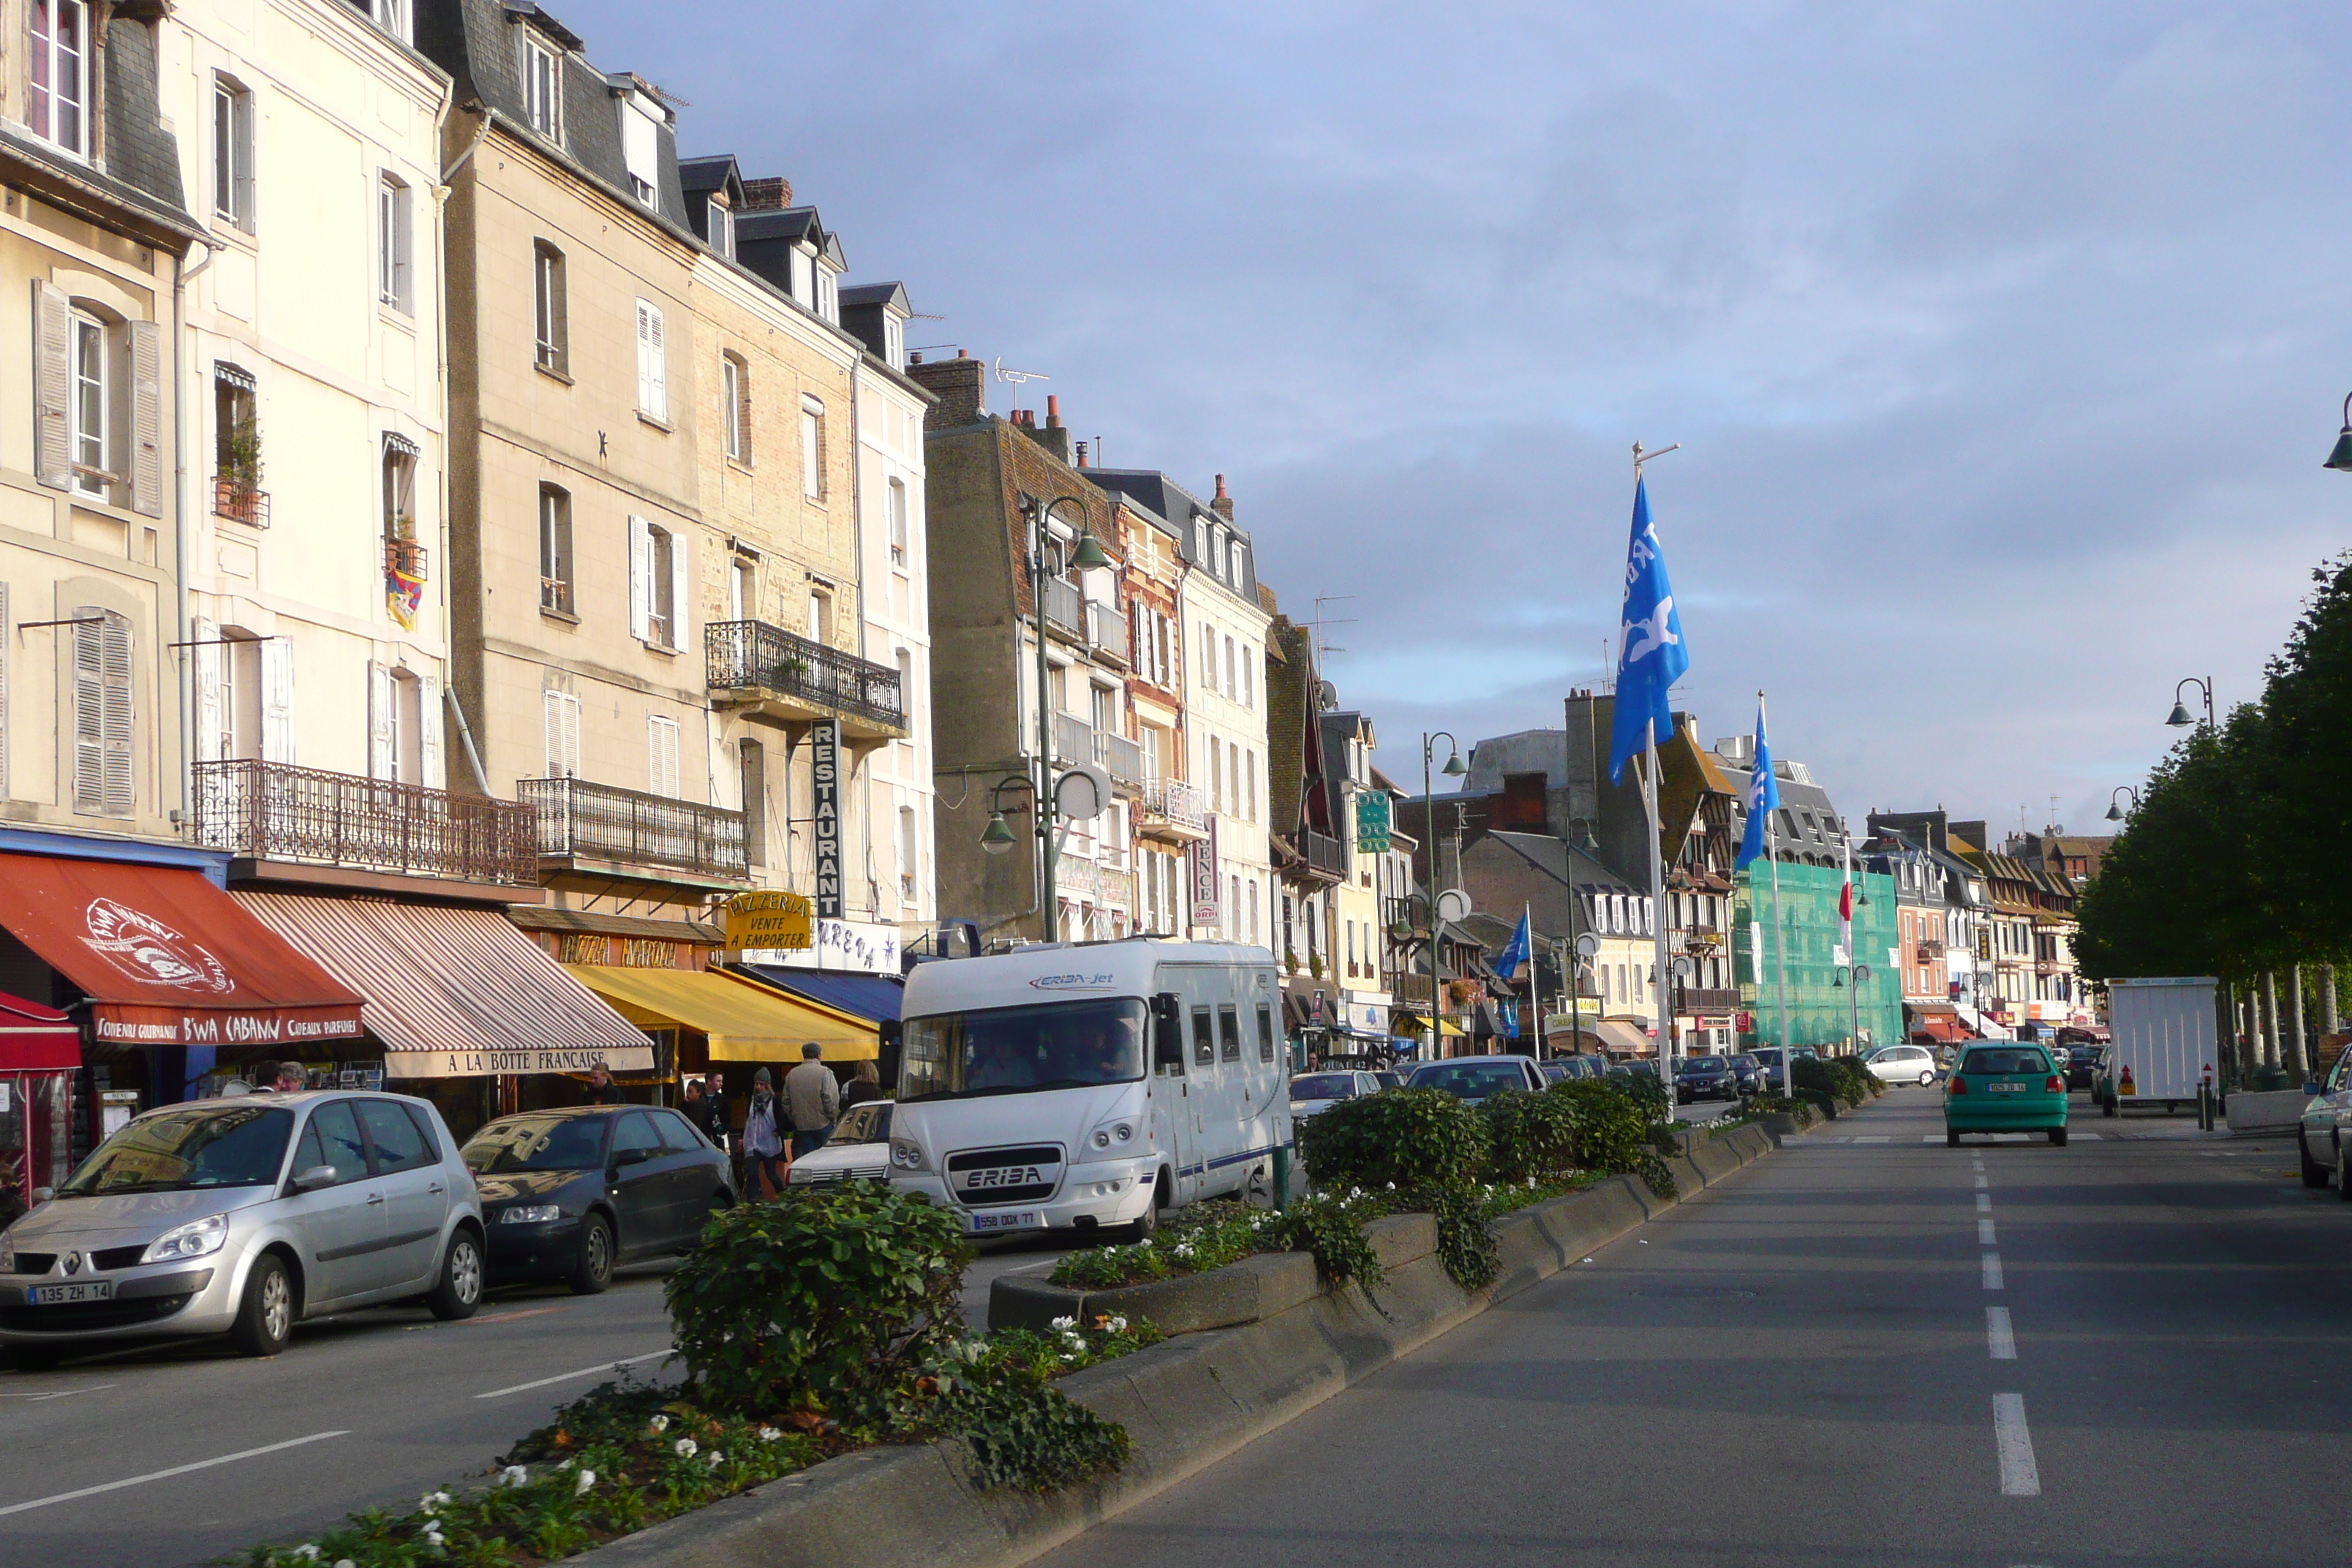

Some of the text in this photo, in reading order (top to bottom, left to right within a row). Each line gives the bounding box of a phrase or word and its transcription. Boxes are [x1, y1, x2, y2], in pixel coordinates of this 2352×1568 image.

[814, 725, 838, 914] RESTAURANT
[728, 894, 807, 918] PIZZERIA
[1194, 910, 1218, 918] ORPI
[750, 917, 785, 930] VENTE
[731, 932, 804, 947] A EMPORTER
[560, 934, 610, 966] PIZZA
[184, 1017, 218, 1043] B'WA
[448, 1054, 458, 1071] A
[466, 1054, 483, 1071] LA
[491, 1052, 523, 1070] BOTTE
[967, 1166, 1041, 1188] ERIBA
[1022, 1213, 1034, 1224] 77
[41, 1284, 108, 1302] 135 ZH 14
